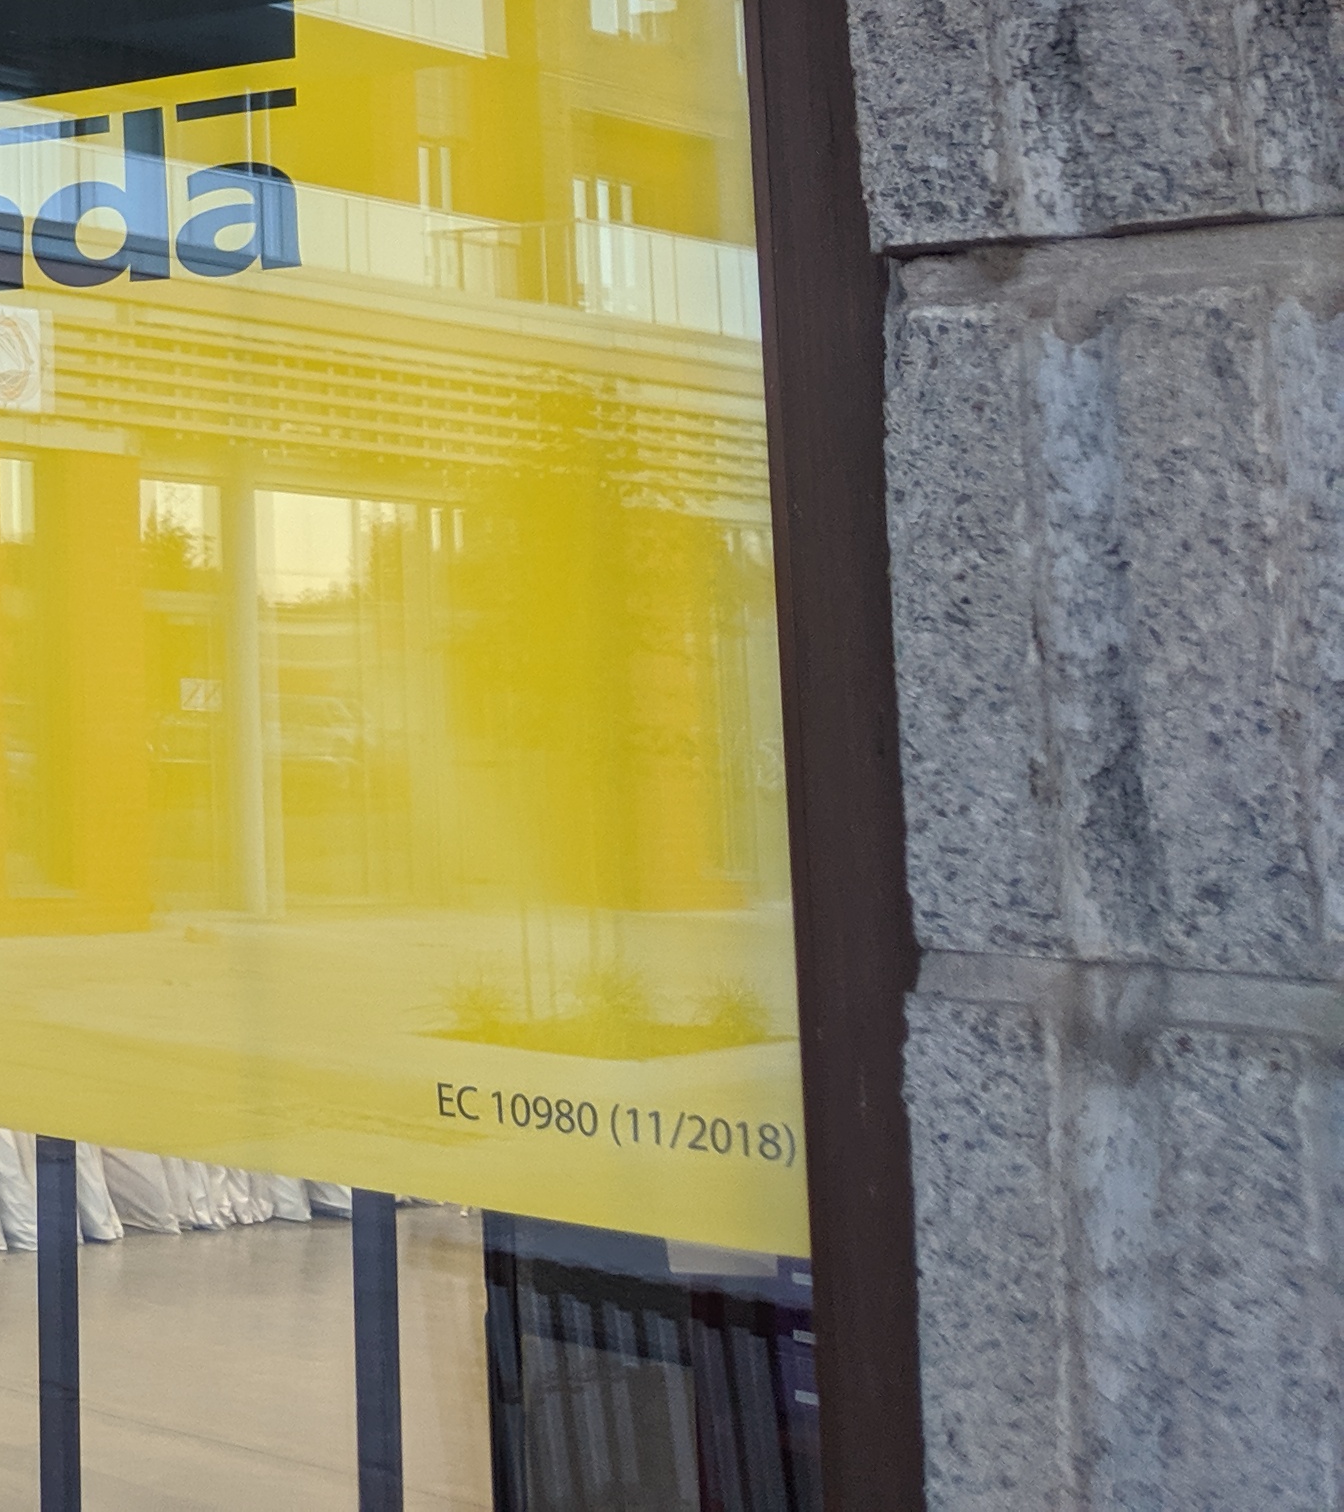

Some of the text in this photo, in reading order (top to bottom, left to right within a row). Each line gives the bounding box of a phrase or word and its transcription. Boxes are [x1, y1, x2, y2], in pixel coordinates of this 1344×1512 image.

[437, 1081, 796, 1168] EC 10980 (11/2018)
